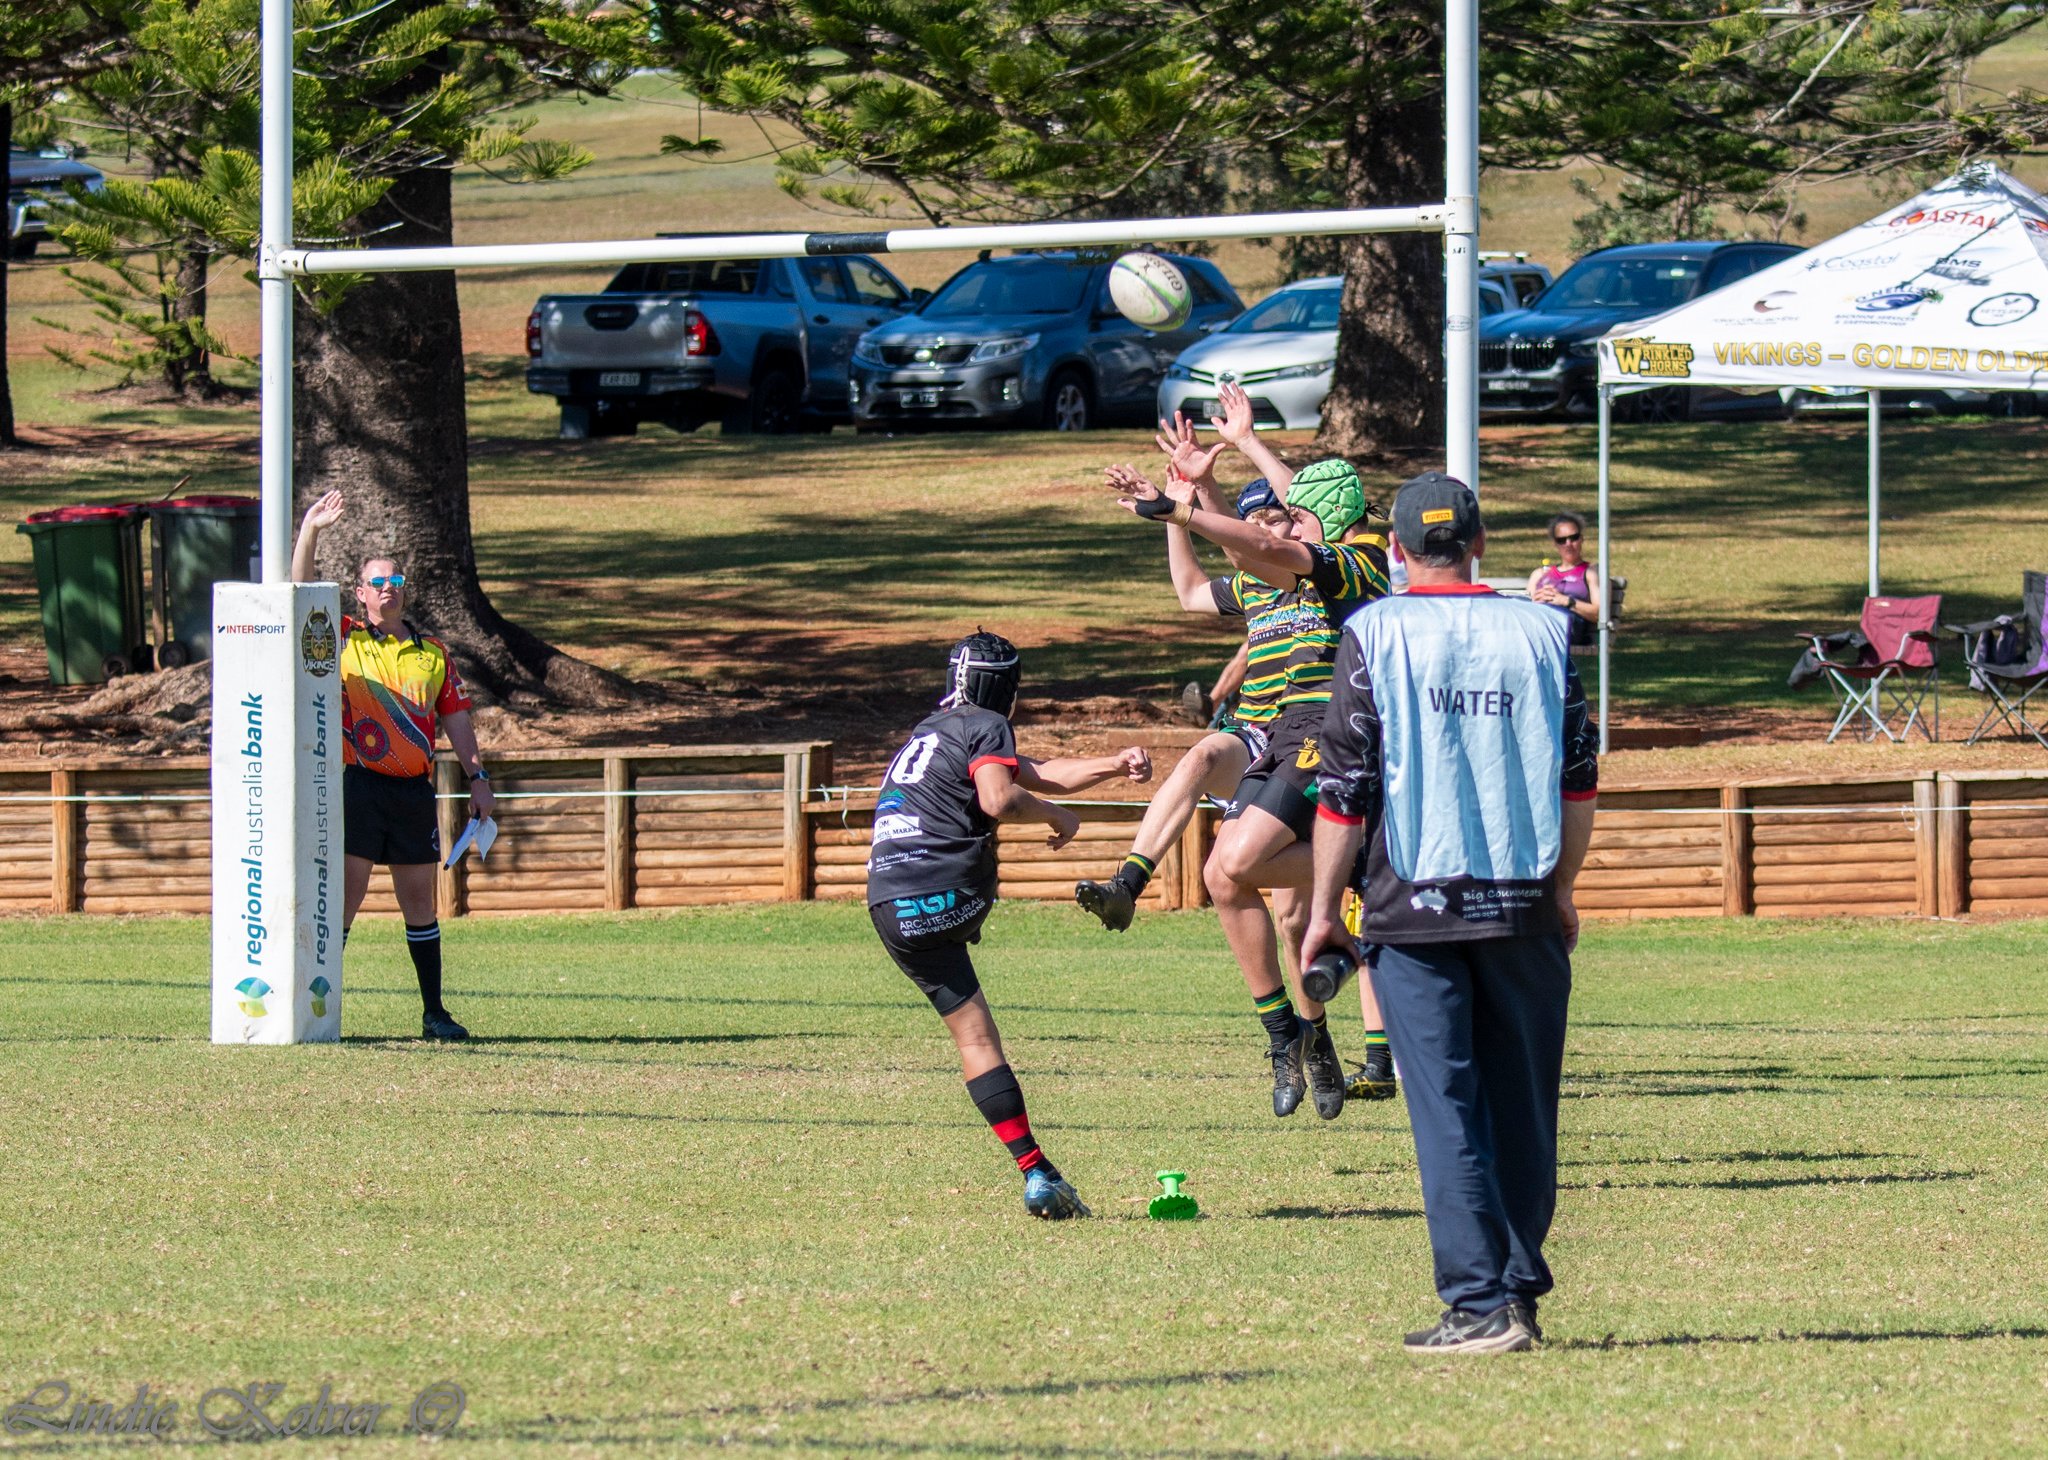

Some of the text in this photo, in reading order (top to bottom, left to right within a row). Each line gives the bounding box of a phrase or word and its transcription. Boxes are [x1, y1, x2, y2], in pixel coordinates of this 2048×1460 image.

[1713, 342, 1822, 366] VIKINGS
[1852, 343, 1968, 371] GOLDEN
[1649, 361, 1687, 371] HORNS
[226, 625, 286, 634] INTERSPORT
[303, 659, 336, 672] VIKINGS
[1428, 687, 1514, 718] WATER
[1462, 889, 1484, 902] Big
[900, 897, 984, 930] ARCHITECTURAL
